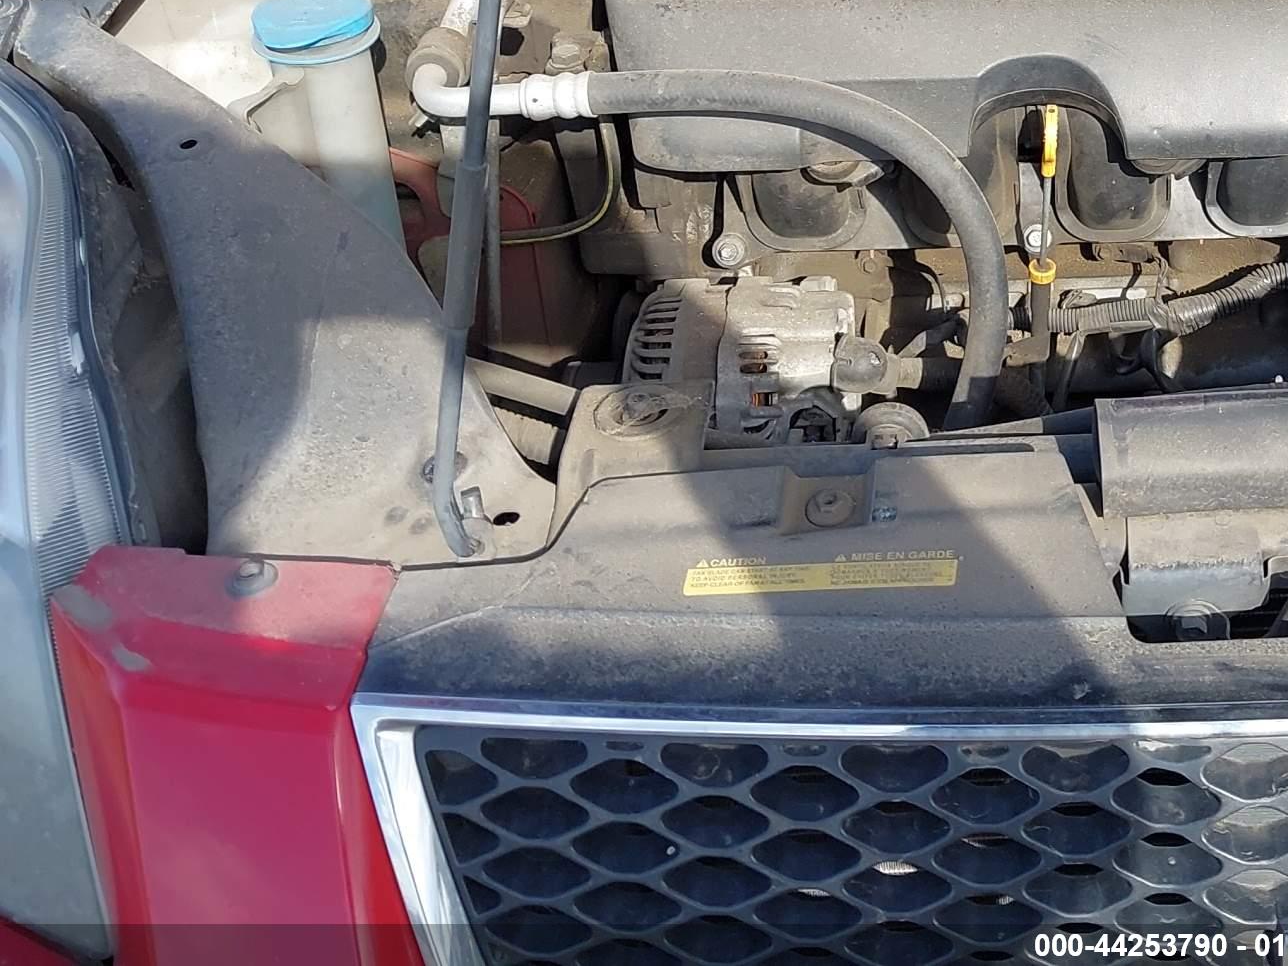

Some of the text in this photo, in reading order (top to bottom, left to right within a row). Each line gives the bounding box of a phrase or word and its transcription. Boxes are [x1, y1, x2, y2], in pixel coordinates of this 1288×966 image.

[850, 549, 955, 562] MISE EN GARDE
[710, 557, 767, 568] CAUTION
